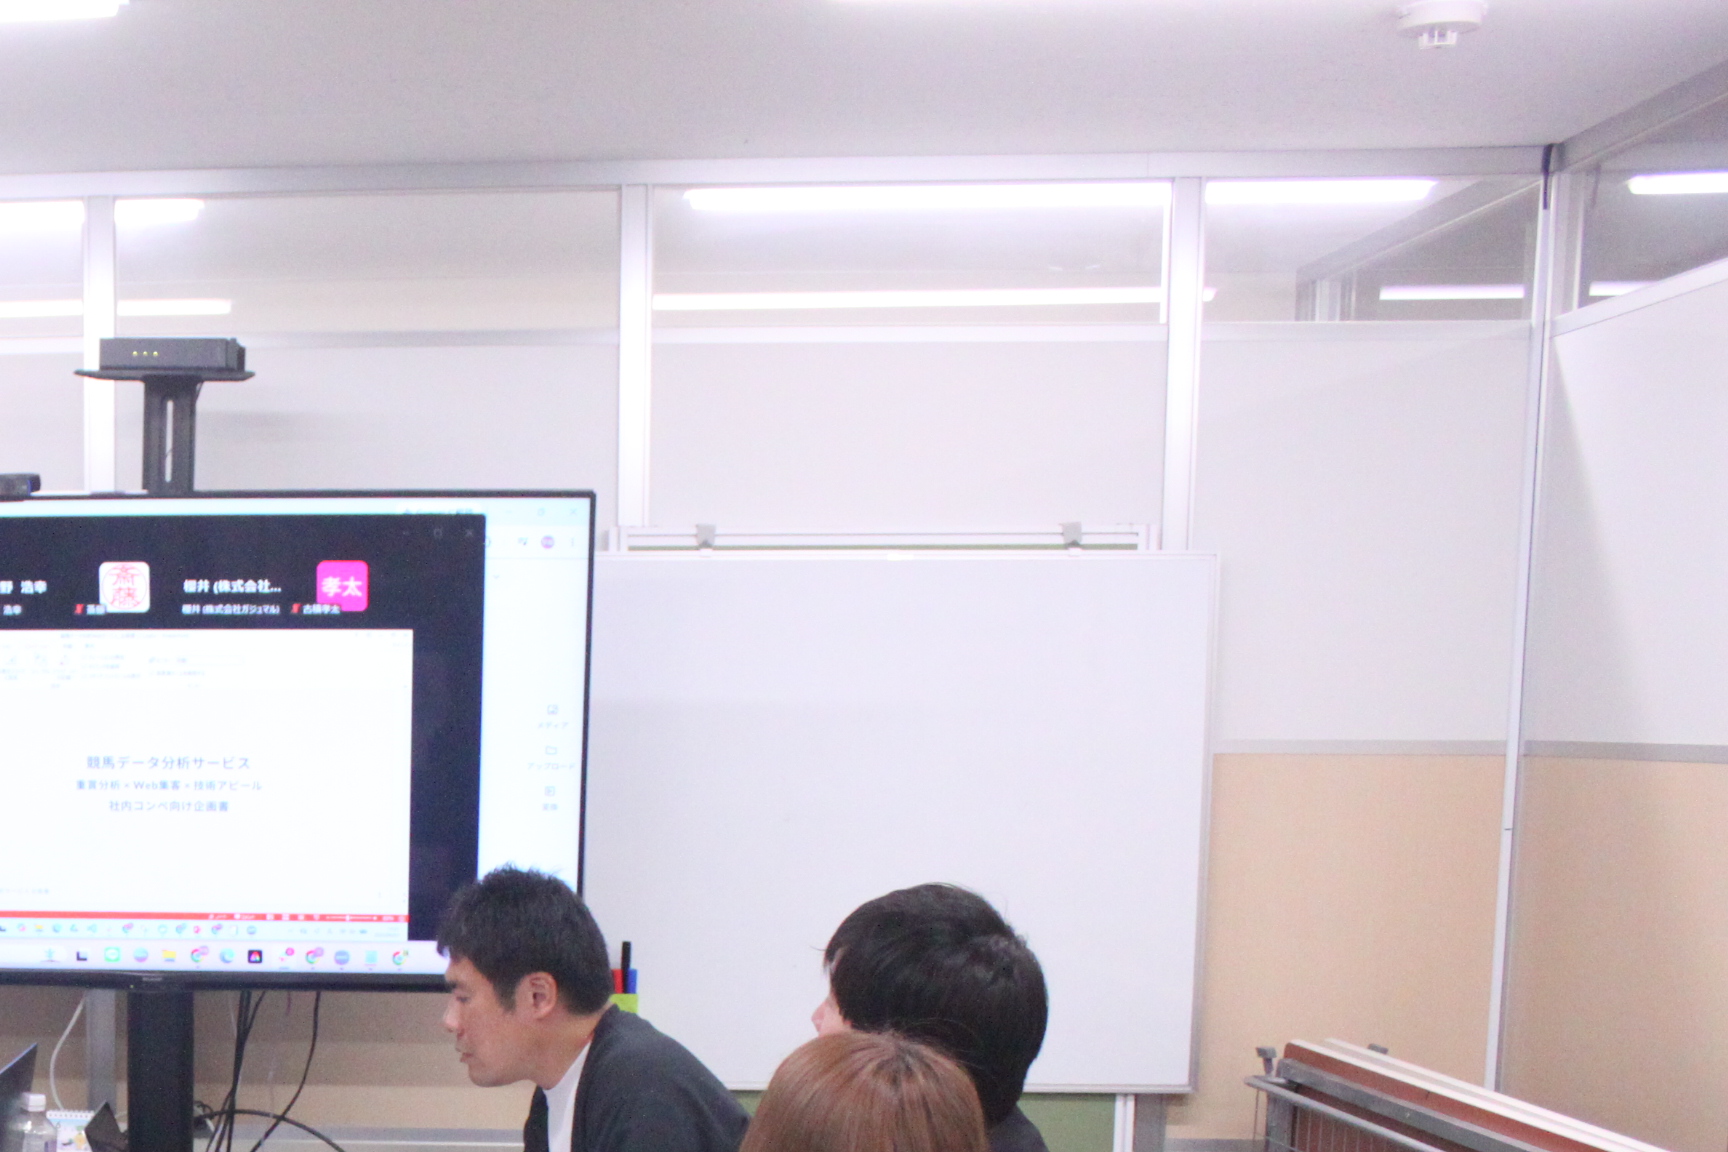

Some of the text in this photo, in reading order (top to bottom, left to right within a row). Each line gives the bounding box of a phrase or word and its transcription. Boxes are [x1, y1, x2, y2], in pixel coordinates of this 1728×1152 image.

[322, 576, 362, 597] 孝太
[86, 756, 251, 770] 競馬データ分析サービス
[194, 780, 262, 791] 技術アピール
[109, 800, 230, 812] 社内コンペ向け企画書
